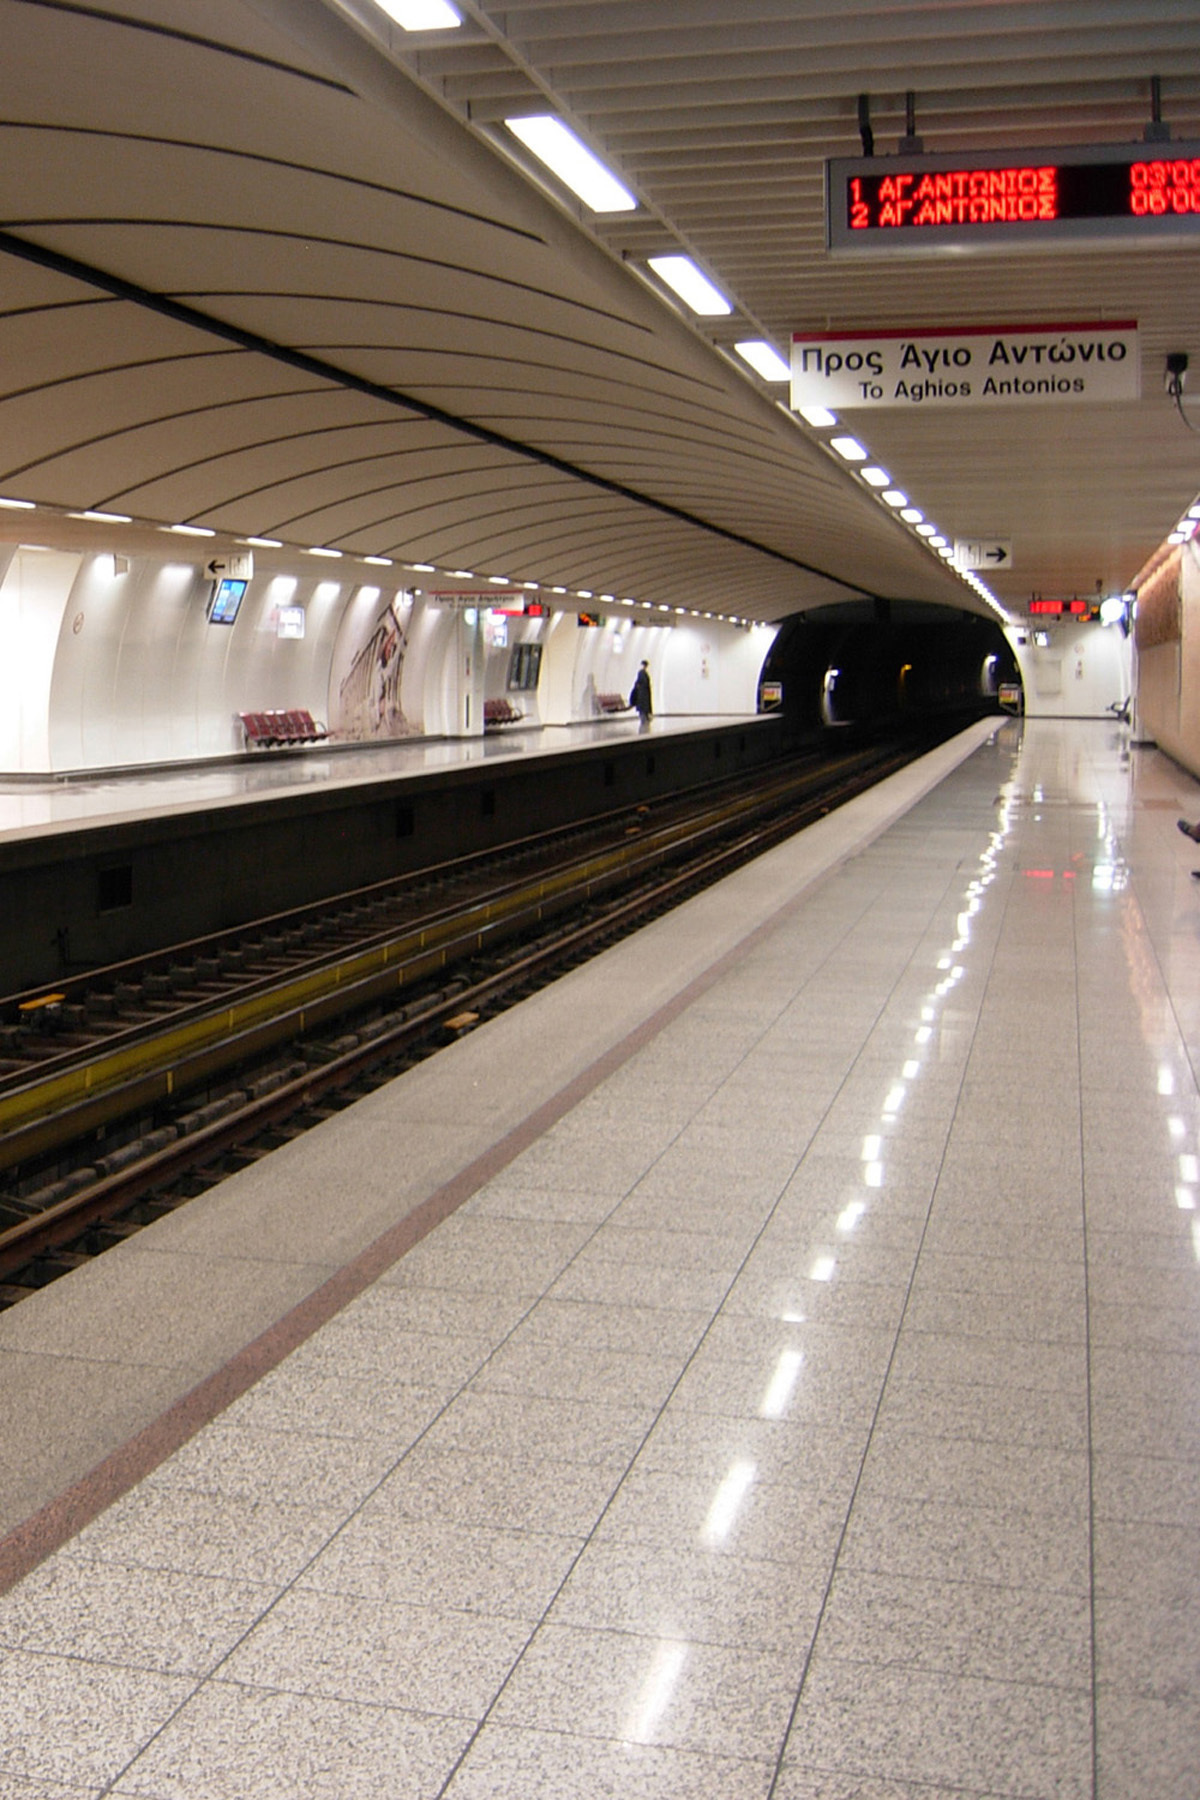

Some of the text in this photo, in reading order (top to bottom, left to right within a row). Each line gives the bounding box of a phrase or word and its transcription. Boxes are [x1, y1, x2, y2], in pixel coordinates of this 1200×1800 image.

[851, 177, 861, 202] 1
[878, 166, 1057, 201] ΑΓ.ΑΝΤΩΝΙΟΣ
[851, 202, 869, 228] 2
[878, 194, 1057, 227] ΑΓ.ΑΝΤΩΝΙΟΣ
[801, 337, 1128, 376] Προς Άγιο Αντώνιο
[858, 375, 1085, 402] To Aghios Antonios
